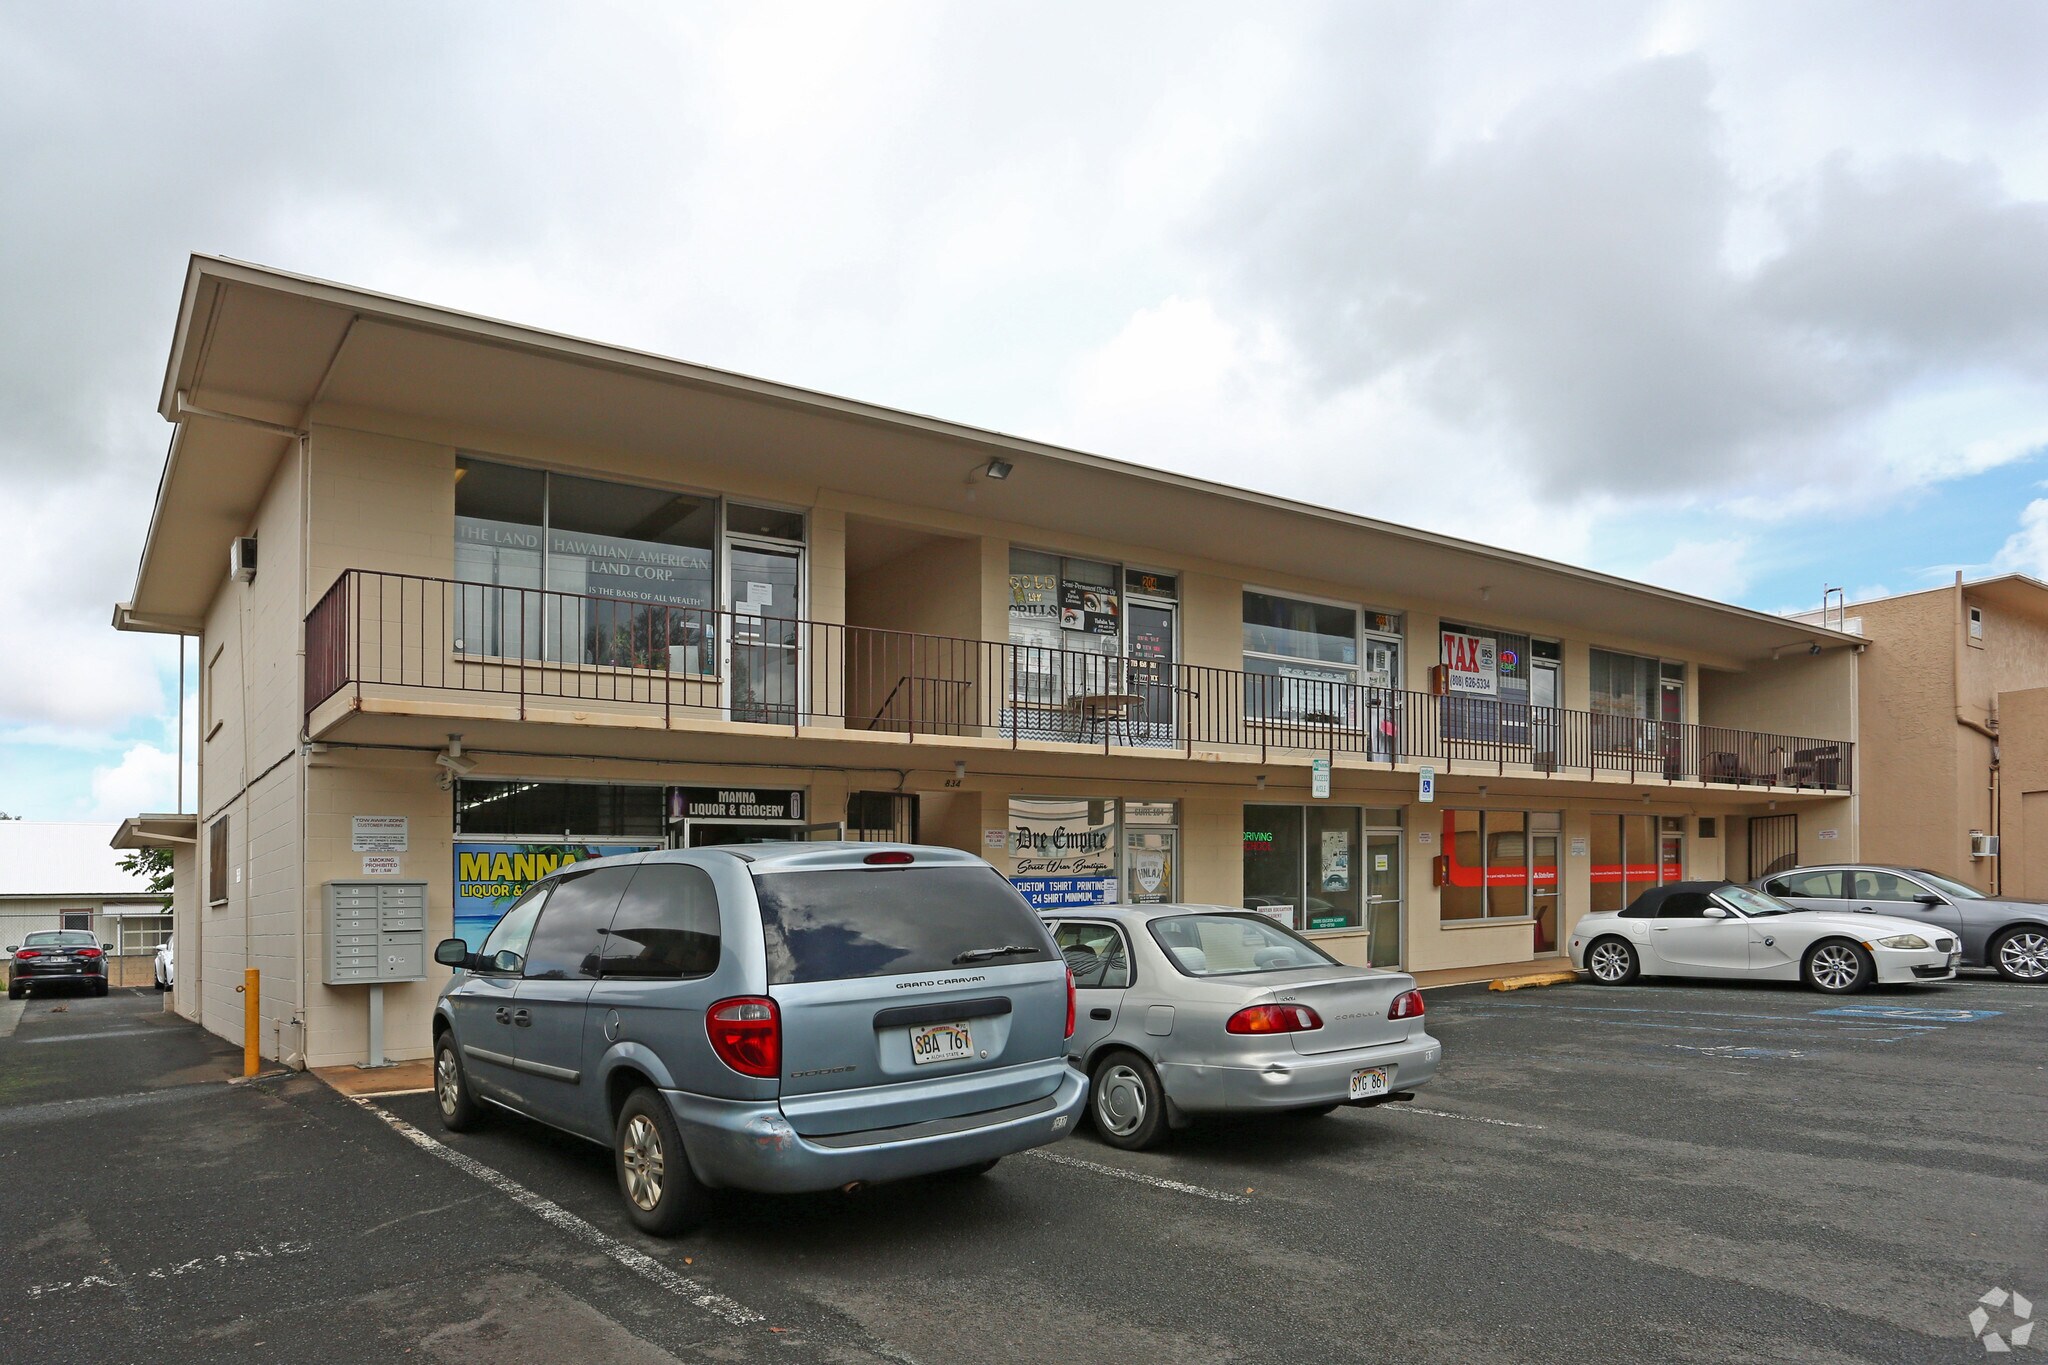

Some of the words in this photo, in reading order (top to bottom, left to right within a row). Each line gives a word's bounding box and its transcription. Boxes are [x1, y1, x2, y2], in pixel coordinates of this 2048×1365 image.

[460, 524, 488, 540] THE
[494, 530, 538, 548] LAND
[638, 551, 709, 570] AMERICAN
[591, 560, 630, 576] LAND
[634, 565, 675, 581] CORP.
[1009, 575, 1056, 590] GOLD
[588, 586, 597, 594] IS
[598, 587, 614, 596] THE
[616, 589, 639, 599] BASIS
[640, 592, 652, 600] OF
[653, 594, 668, 603] ALL
[1009, 604, 1058, 618] GRILLS
[1444, 633, 1480, 674] TAX
[1314, 774, 1329, 782] ACCESS
[718, 790, 756, 803] MANNA
[689, 803, 726, 816] LIQUOR
[728, 804, 736, 816] &
[739, 805, 784, 817] GROCERY
[1015, 825, 1047, 850] Dre
[1052, 825, 1107, 853] Empire
[1242, 831, 1273, 842] DRIVING
[461, 884, 509, 899] LIQUOR
[513, 884, 523, 898] &
[1017, 881, 1045, 892] CUSTOM
[1049, 881, 1072, 891] TSHIRT
[1032, 893, 1042, 904] 24
[1043, 892, 1064, 904] SHIRT
[896, 981, 934, 989] GRAND
[937, 975, 986, 985] CARAVAN
[1334, 1010, 1380, 1021] COROLLA
[915, 1033, 940, 1055] SBA
[946, 1029, 969, 1051] 767
[790, 1065, 857, 1079] DODGE
[1352, 1075, 1367, 1092] SYG
[1371, 1072, 1387, 1089] 867
